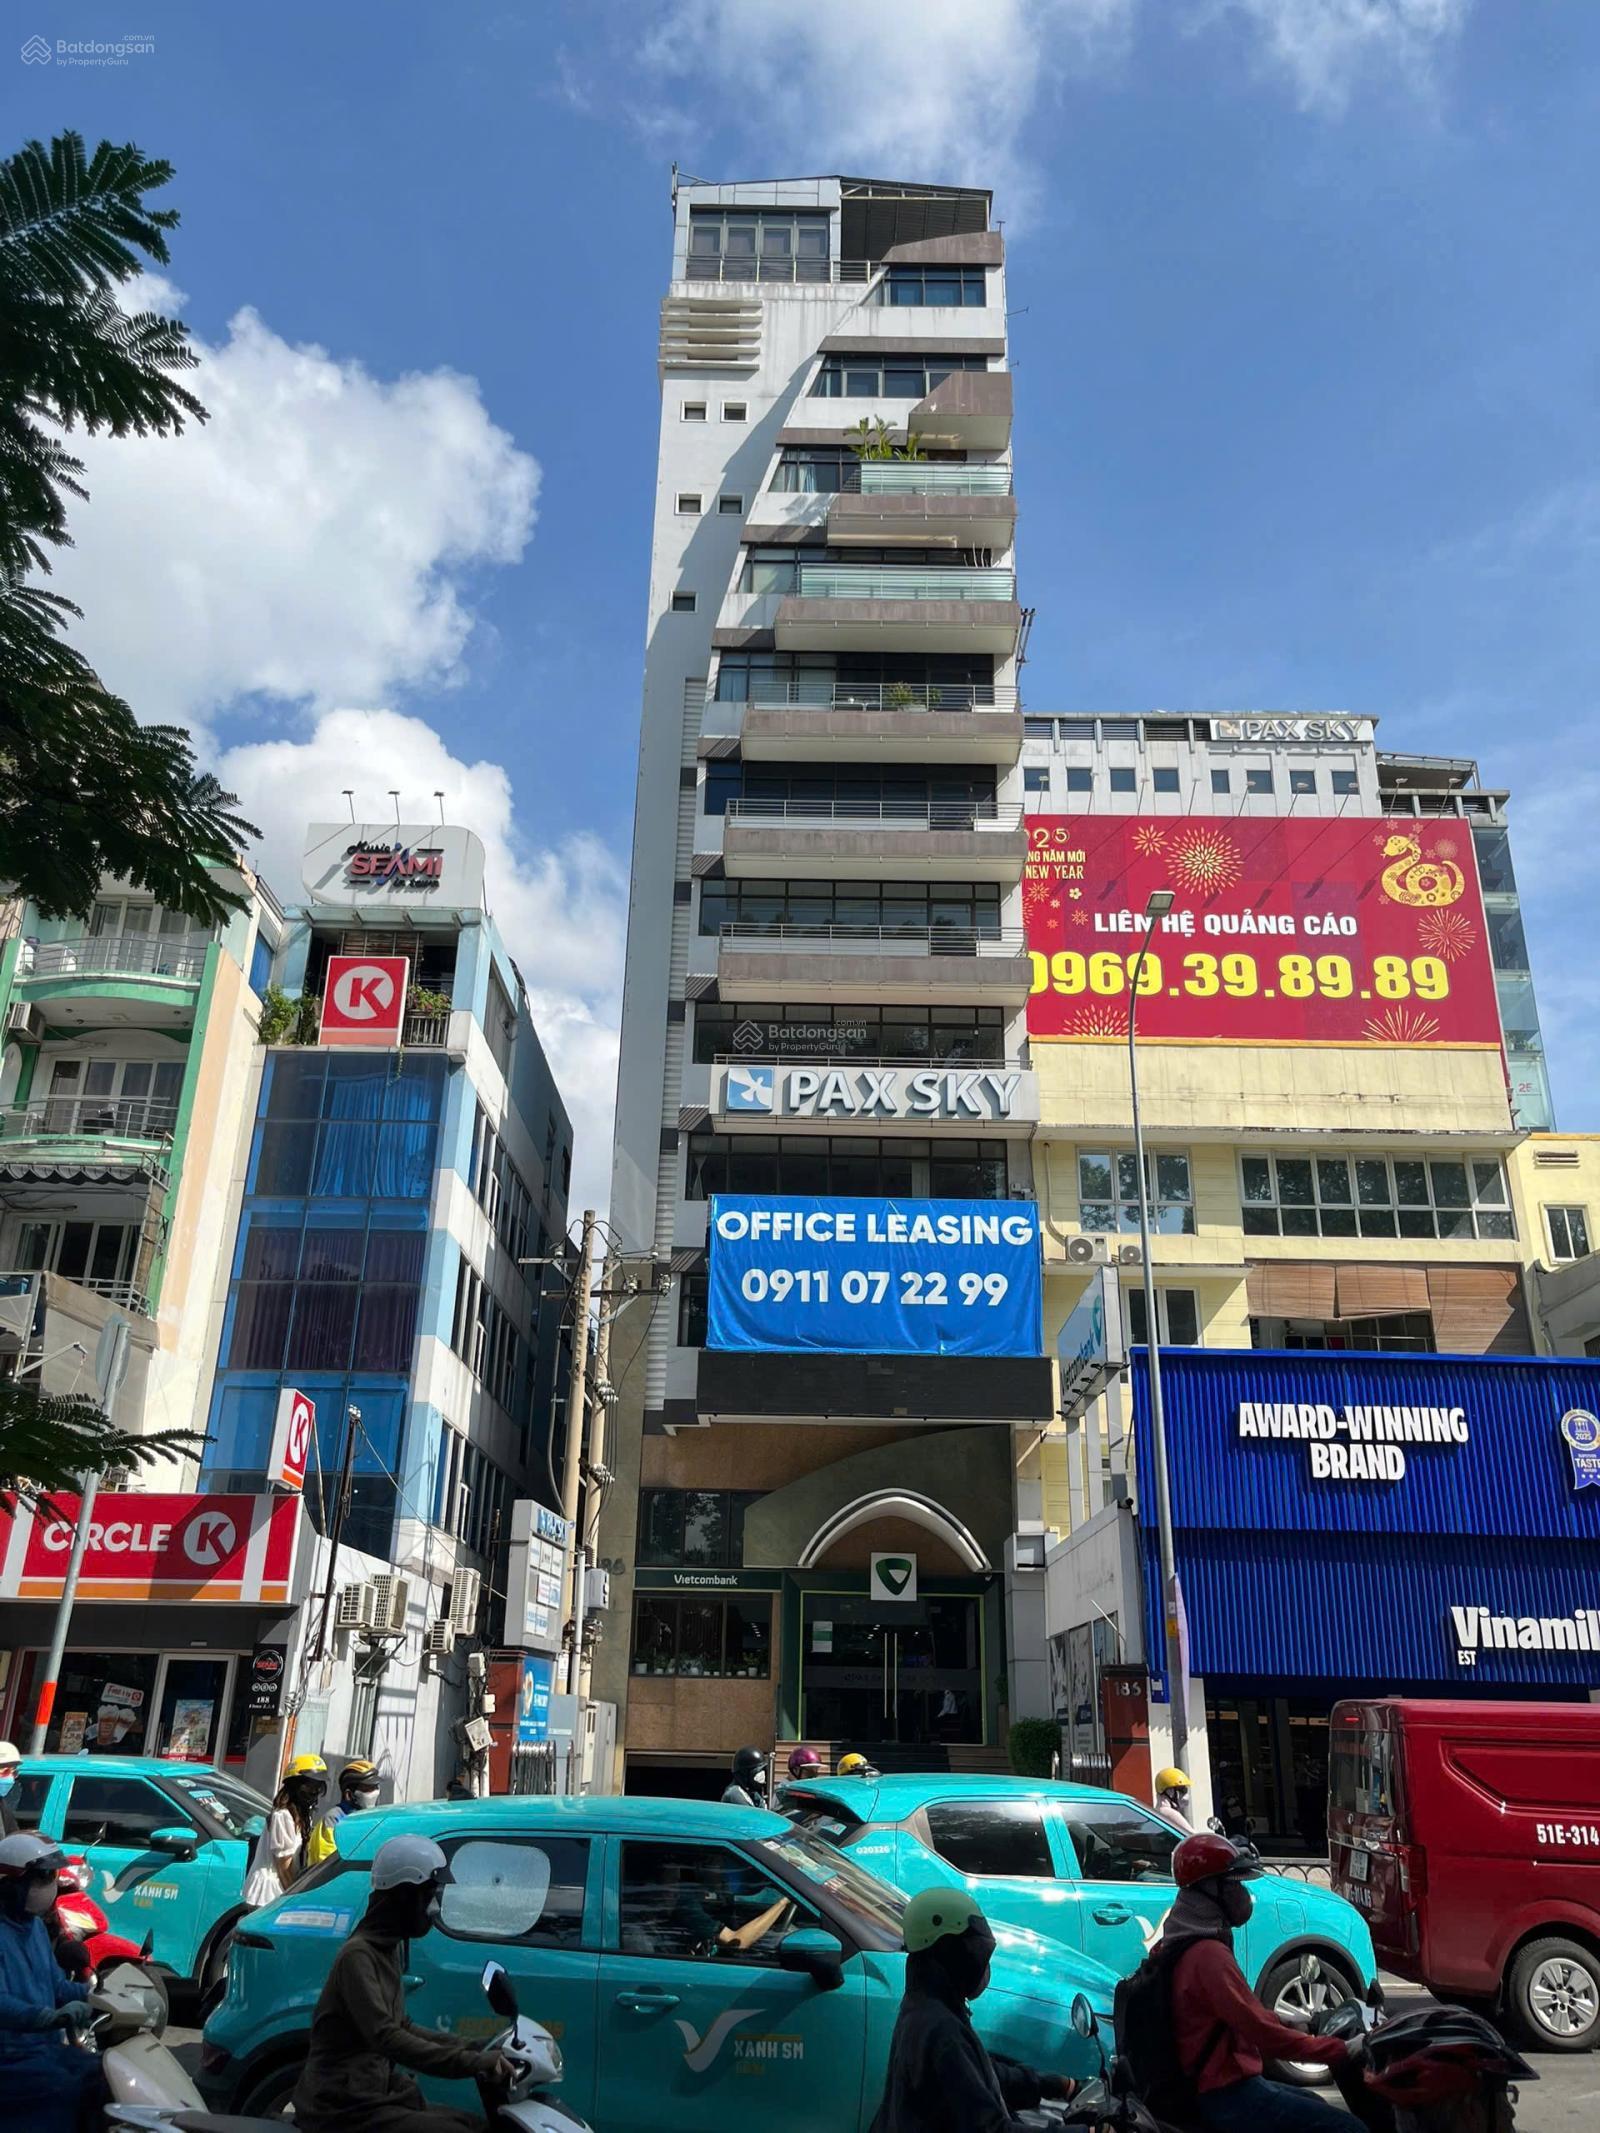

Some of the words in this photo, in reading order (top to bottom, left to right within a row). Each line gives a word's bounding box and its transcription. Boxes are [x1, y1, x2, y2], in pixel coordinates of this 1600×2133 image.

[1246, 720, 1300, 739] PAX
[1305, 720, 1362, 739] SKY
[1042, 849, 1065, 863] NĂM
[1067, 849, 1086, 863] MỚI
[1025, 865, 1050, 879] NEW
[1053, 865, 1084, 879] YEAR
[1094, 909, 1152, 933] LIÊN
[1161, 910, 1196, 937] HỆ
[1203, 908, 1296, 936] QUẢNG
[1302, 912, 1358, 936] CÁO
[789, 1070, 897, 1112] PAX
[912, 1072, 1020, 1114] SKY
[717, 1211, 856, 1242] OFFICE
[867, 1214, 1033, 1246] LEASING
[741, 1268, 829, 1303] 0911
[841, 1270, 890, 1304] 07
[900, 1271, 948, 1305] 22
[958, 1272, 1009, 1306] 99
[1239, 1402, 1469, 1443] AWARD-WINNING
[1310, 1442, 1406, 1480] BRAND
[673, 1574, 738, 1585] Vietcombank
[1450, 1606, 1600, 1651] Vinamil
[1457, 1650, 1477, 1666] EST
[1536, 1823, 1600, 1846] 51E-314
[134, 1885, 163, 1899] XANH
[164, 1887, 179, 1900] SM
[734, 2040, 778, 2059] XANH
[781, 2042, 804, 2060] SM
